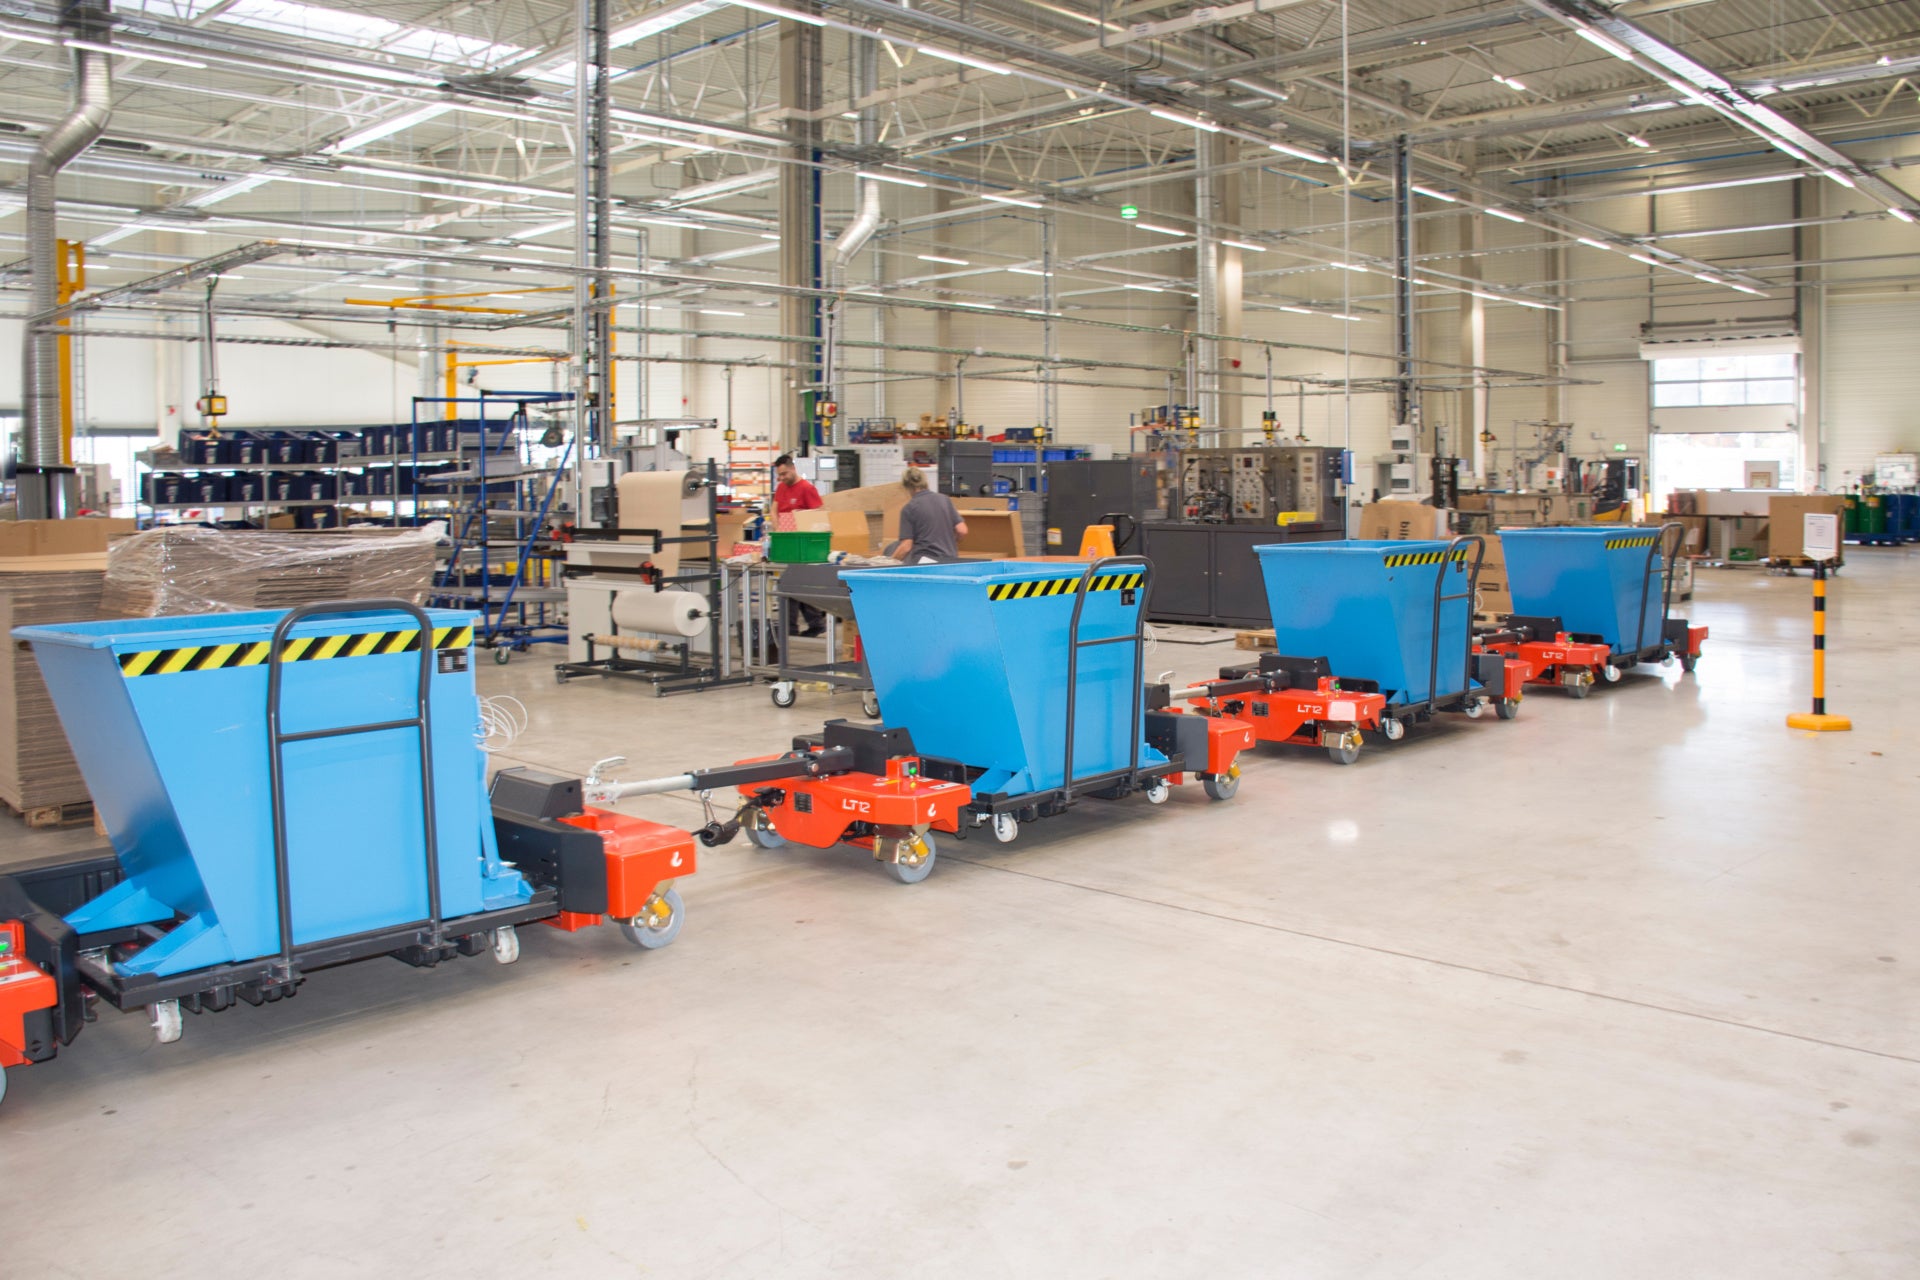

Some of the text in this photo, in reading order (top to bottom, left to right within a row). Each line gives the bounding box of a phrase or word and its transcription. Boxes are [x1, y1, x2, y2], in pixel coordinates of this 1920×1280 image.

[1542, 651, 1564, 660] LT12
[1297, 704, 1323, 714] LT12
[842, 798, 871, 814] LT12
